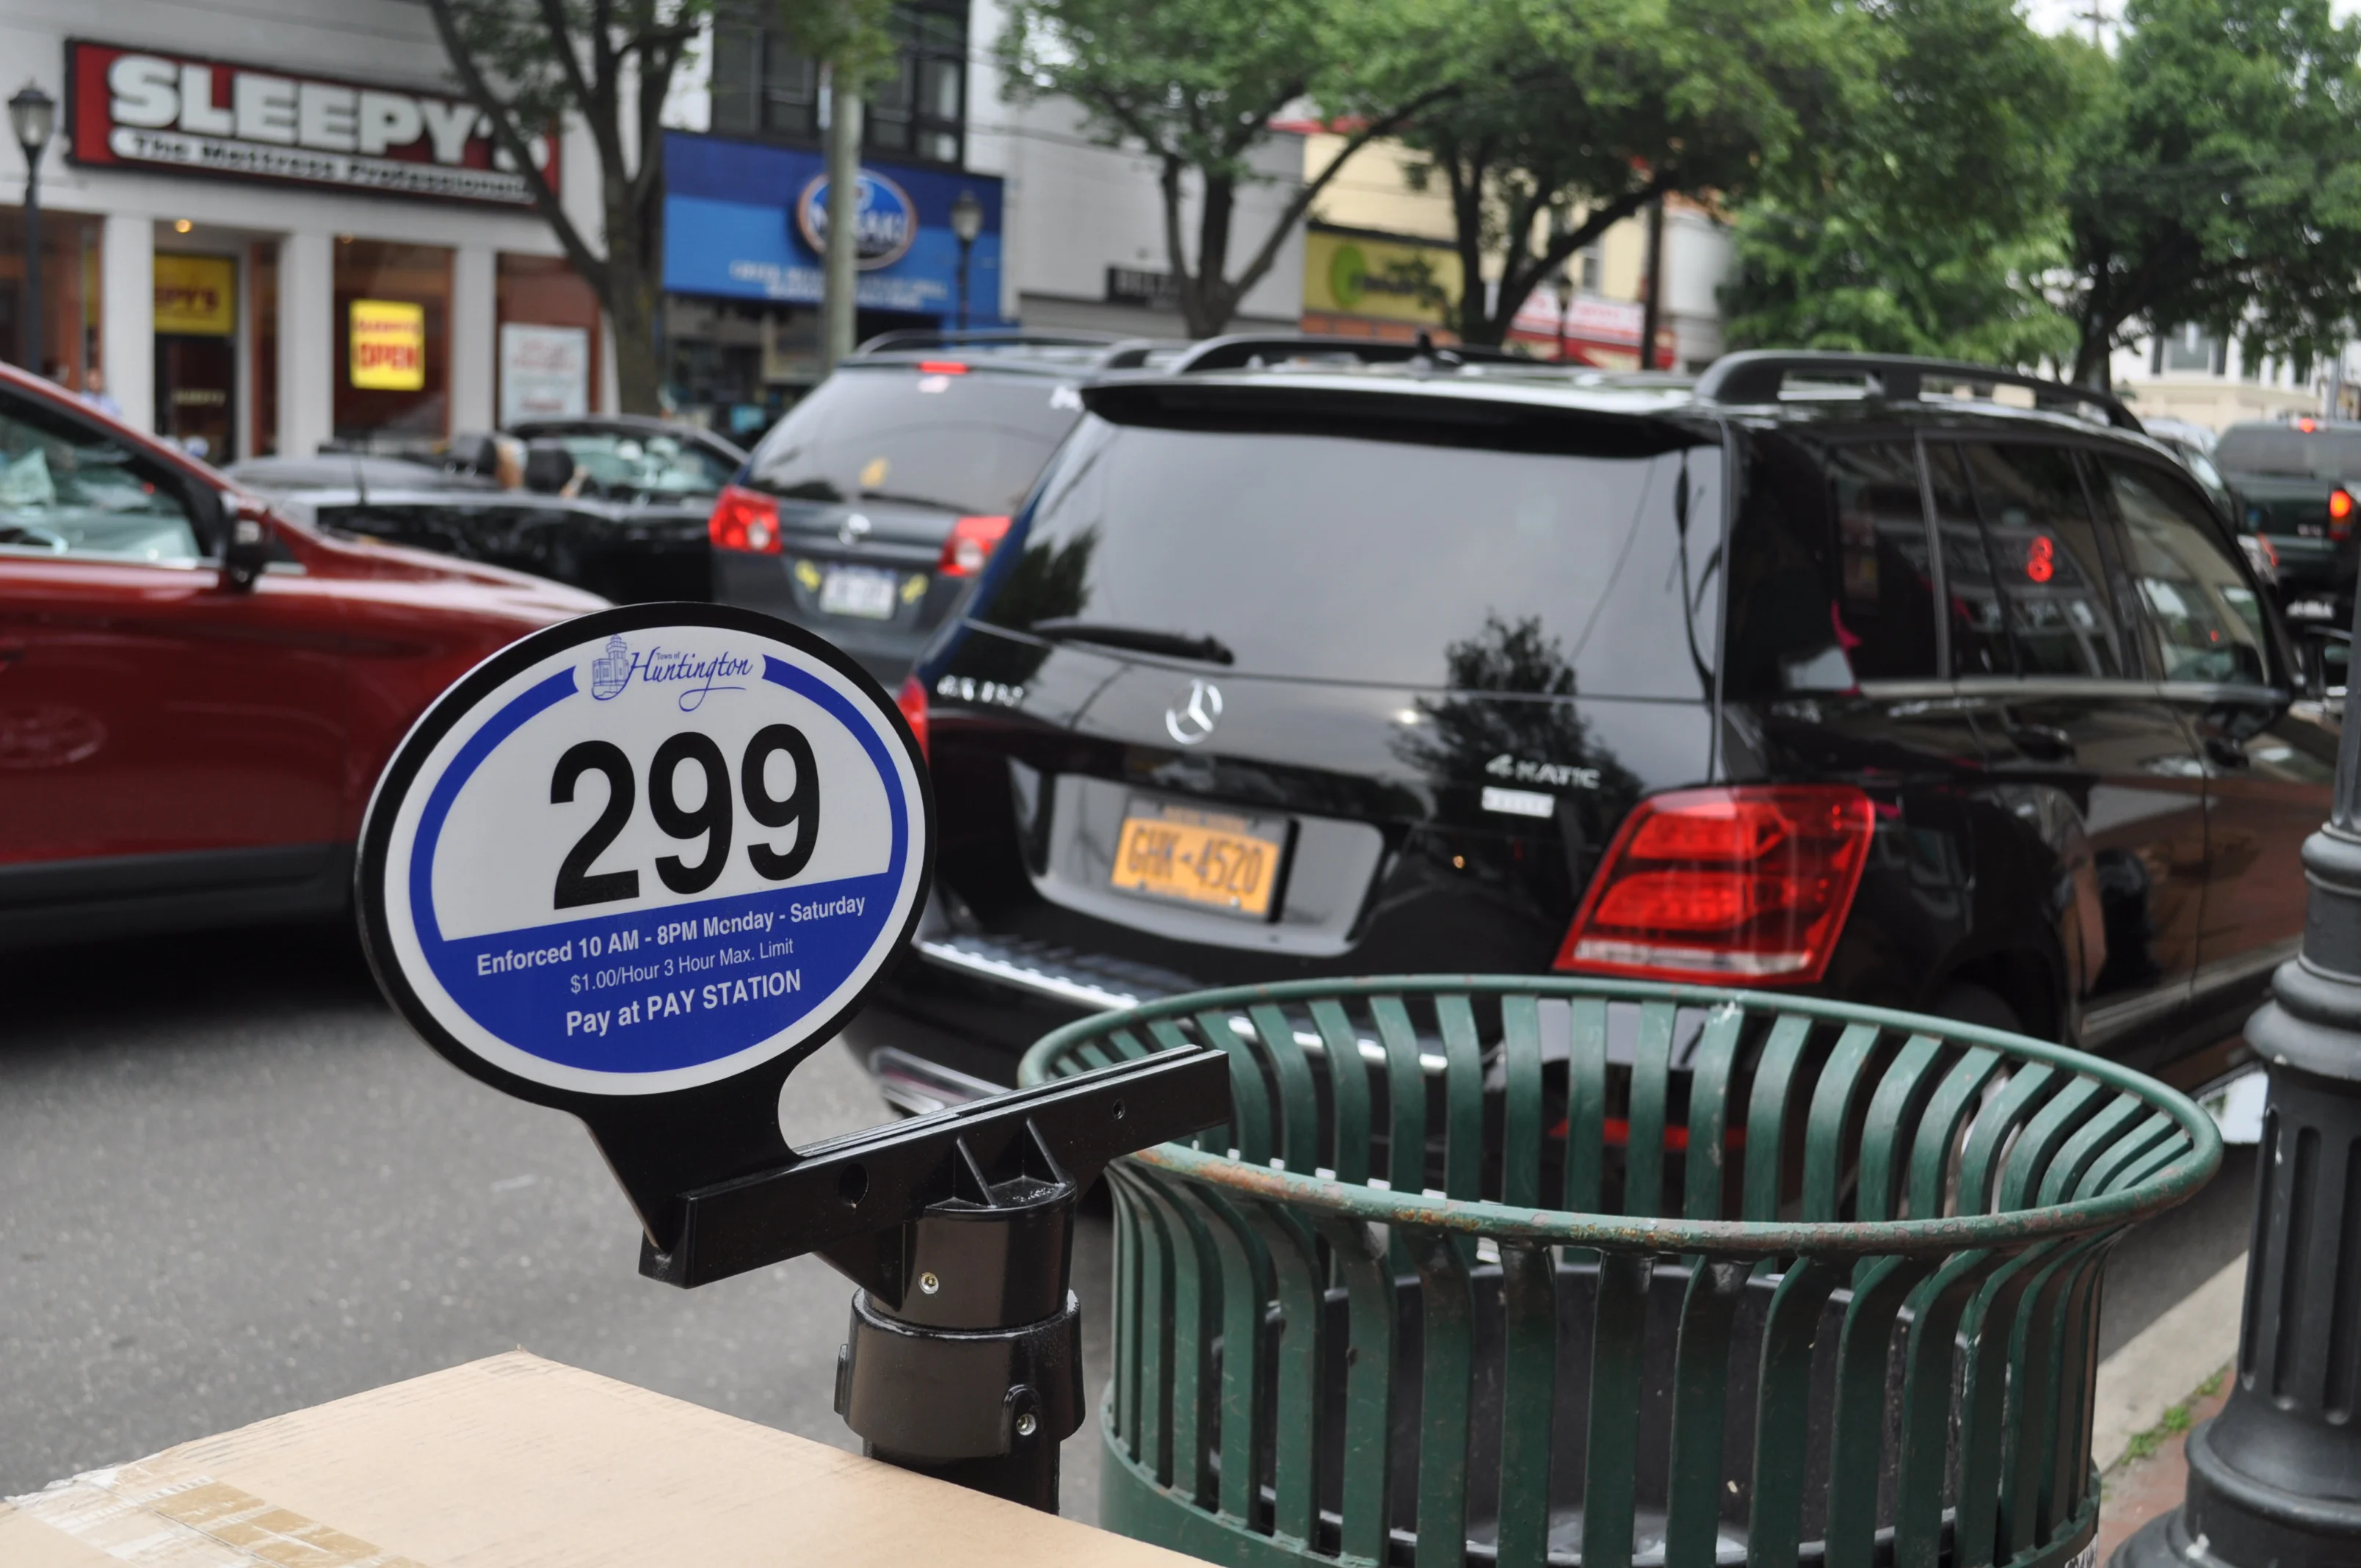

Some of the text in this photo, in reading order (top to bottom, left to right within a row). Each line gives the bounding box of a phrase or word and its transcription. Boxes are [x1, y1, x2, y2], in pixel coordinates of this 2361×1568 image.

[615, 646, 754, 711] Huntington
[656, 651, 681, 661] Town of
[551, 724, 820, 910] 299
[477, 940, 573, 976] Enforced
[579, 936, 602, 958] 10
[608, 929, 639, 954] AM
[657, 921, 697, 945] 8PM
[703, 911, 774, 937] Monday
[790, 896, 866, 923] Saturday
[570, 938, 794, 995] $1.00/Hour 3 Hour Max. Limit
[566, 968, 801, 1037] Pay at PAY STATION
